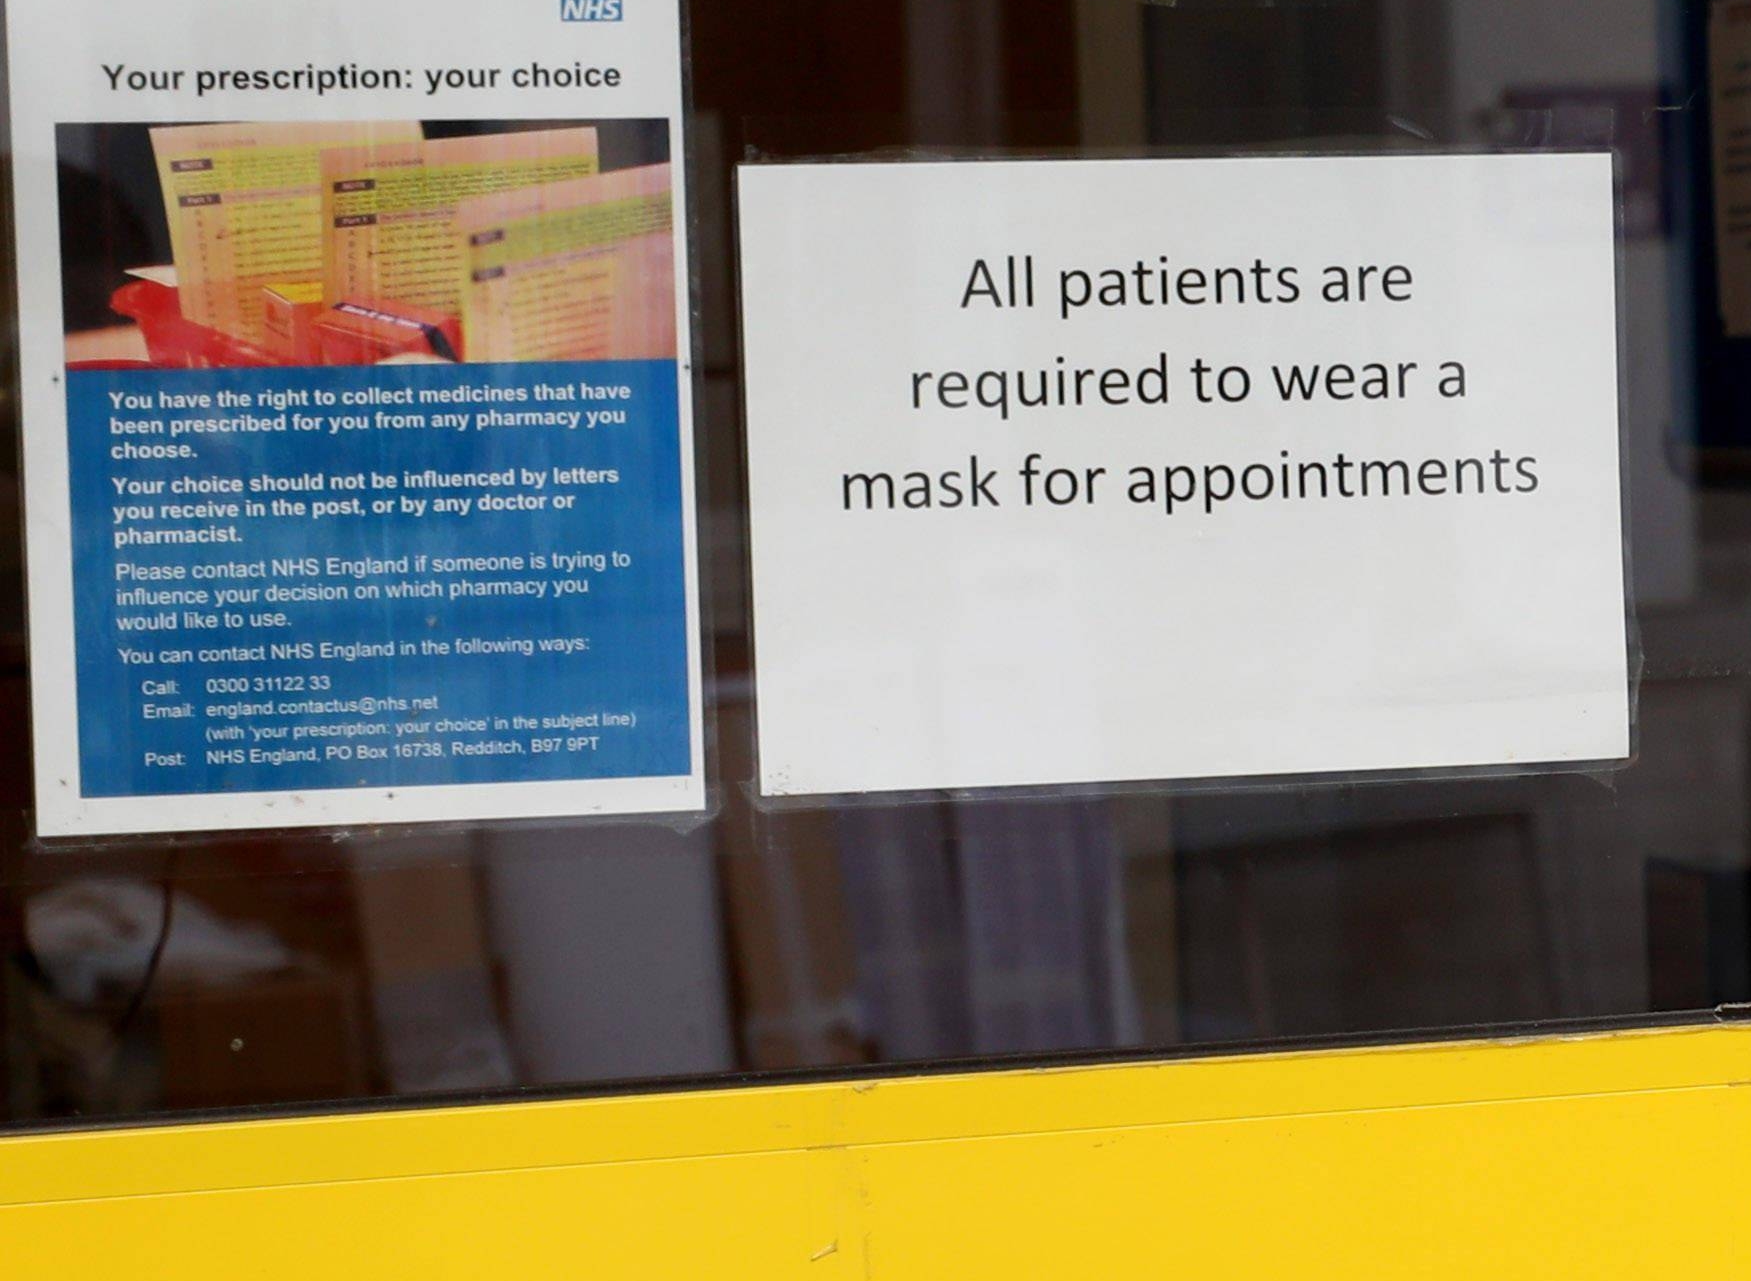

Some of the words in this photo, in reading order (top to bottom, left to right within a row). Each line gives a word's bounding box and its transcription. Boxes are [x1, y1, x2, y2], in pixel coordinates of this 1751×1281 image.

[101, 64, 184, 90] Your
[196, 64, 412, 95] prescription:
[424, 68, 500, 95] your
[511, 62, 620, 87] choice
[960, 255, 1033, 307] All
[1060, 256, 1300, 317] patients
[1321, 265, 1412, 302] are
[107, 391, 152, 409] You
[158, 391, 212, 408] have
[215, 389, 252, 407] the
[256, 388, 308, 410] right
[312, 389, 336, 405] to
[340, 386, 414, 405] collect
[418, 384, 528, 403] medicines
[532, 383, 575, 401] that
[579, 382, 632, 400] have
[912, 353, 1168, 418] required
[1189, 358, 1250, 403] to
[1270, 362, 1417, 400] wear
[1438, 361, 1465, 397] a
[109, 416, 164, 433] been
[169, 413, 286, 436] prescribed
[291, 412, 324, 430] for
[327, 415, 369, 434] you
[374, 411, 425, 428] from
[430, 413, 470, 431] any
[475, 409, 581, 429] pharmacy
[584, 409, 626, 428] you
[110, 442, 198, 459] choose.
[110, 476, 166, 493] Your
[170, 475, 244, 492] choice
[248, 472, 324, 490] should
[329, 472, 365, 489] not
[370, 471, 397, 488] be
[403, 468, 515, 487] influenced
[520, 467, 547, 489] by
[552, 466, 619, 484] letters
[842, 455, 1000, 509] mask
[1018, 453, 1106, 505] for
[1126, 451, 1538, 513] appointments
[114, 562, 186, 580] Please
[191, 560, 266, 578] contact
[270, 557, 320, 576] NHS
[324, 556, 408, 578] England
[414, 554, 428, 572] if
[431, 556, 524, 572] someone
[529, 552, 546, 569] is
[550, 551, 606, 572] trying
[611, 550, 631, 567] to
[115, 611, 177, 630] would
[182, 611, 218, 628] like
[222, 611, 244, 628] to
[249, 612, 291, 627] use.
[116, 647, 154, 664] You
[158, 649, 193, 663] can
[197, 645, 266, 662] contact
[270, 642, 314, 659] NHS
[318, 641, 395, 661] England
[399, 640, 416, 655] in
[420, 639, 450, 655] the
[453, 637, 534, 656] following
[537, 637, 590, 654] ways:
[140, 679, 180, 695] Call:
[205, 677, 250, 693] 0300
[252, 675, 305, 692] 31122
[308, 674, 331, 690] 33
[142, 702, 195, 719] Email:
[144, 751, 185, 766] Post:
[206, 748, 245, 764] NHS
[248, 747, 320, 765] England,
[324, 744, 353, 760] PO
[355, 743, 389, 759] Box
[391, 742, 447, 758] 16738,
[450, 740, 526, 755] Redditch,
[530, 737, 562, 753] B97
[565, 735, 600, 751] 9PT
